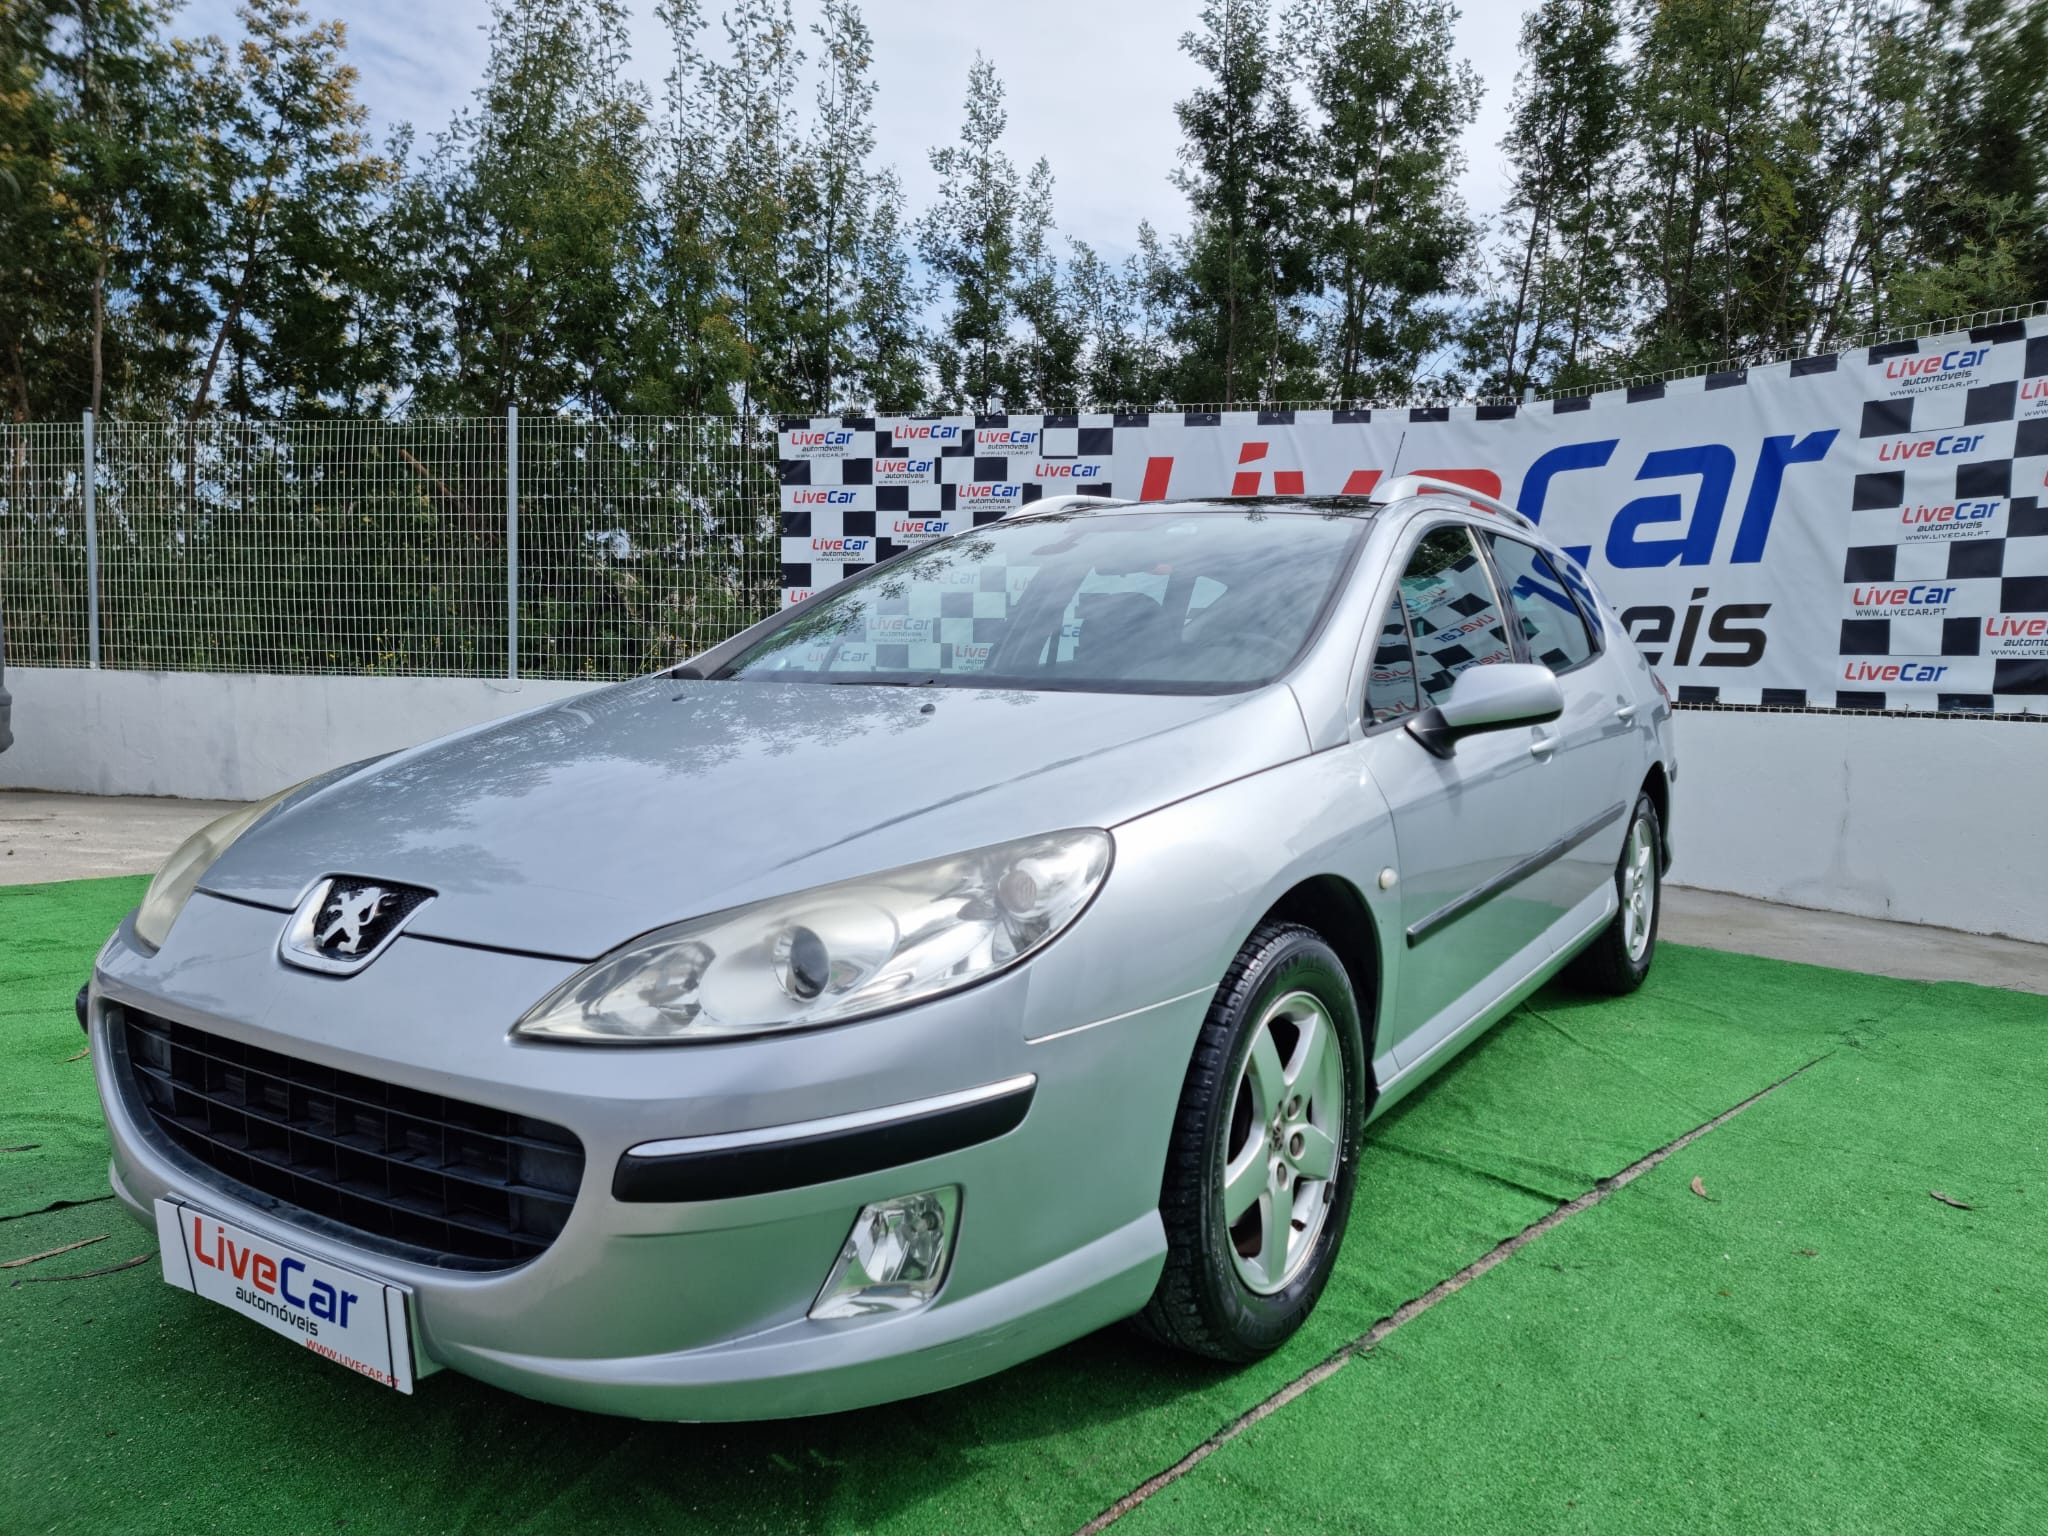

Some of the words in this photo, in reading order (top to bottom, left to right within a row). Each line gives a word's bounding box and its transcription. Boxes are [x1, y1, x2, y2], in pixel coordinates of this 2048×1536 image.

[1886, 349, 1990, 379] LiveCar
[1902, 370, 1972, 387] automóveis
[1890, 379, 1981, 397] WWW.LIVECAR.PT
[791, 432, 853, 445] LiveCar
[894, 425, 960, 439] LiveCar
[978, 431, 1038, 444] LiveCar
[1879, 434, 1985, 462] LiveCar
[875, 460, 933, 473] LiveCar
[1035, 463, 1101, 477] LiveCar
[793, 490, 856, 504] LiveCar
[958, 484, 1021, 497] LiveCar
[1902, 502, 2000, 524] LiveCar
[893, 520, 950, 532] LiveCar
[1917, 521, 1983, 532] automóveis
[1905, 530, 1990, 541] WWW.LIVECAR.PT
[812, 538, 869, 551] LiveCar
[1853, 586, 1957, 605] LiveCar
[1855, 608, 1947, 617] WWW.LIVECAR.PT
[1985, 616, 2048, 636] Live
[1844, 661, 1948, 682] LiveCar
[194, 1216, 358, 1328] LiveCar
[235, 1285, 319, 1336] automóveis
[305, 1338, 400, 1389] WWW.LIVECAR.PT
